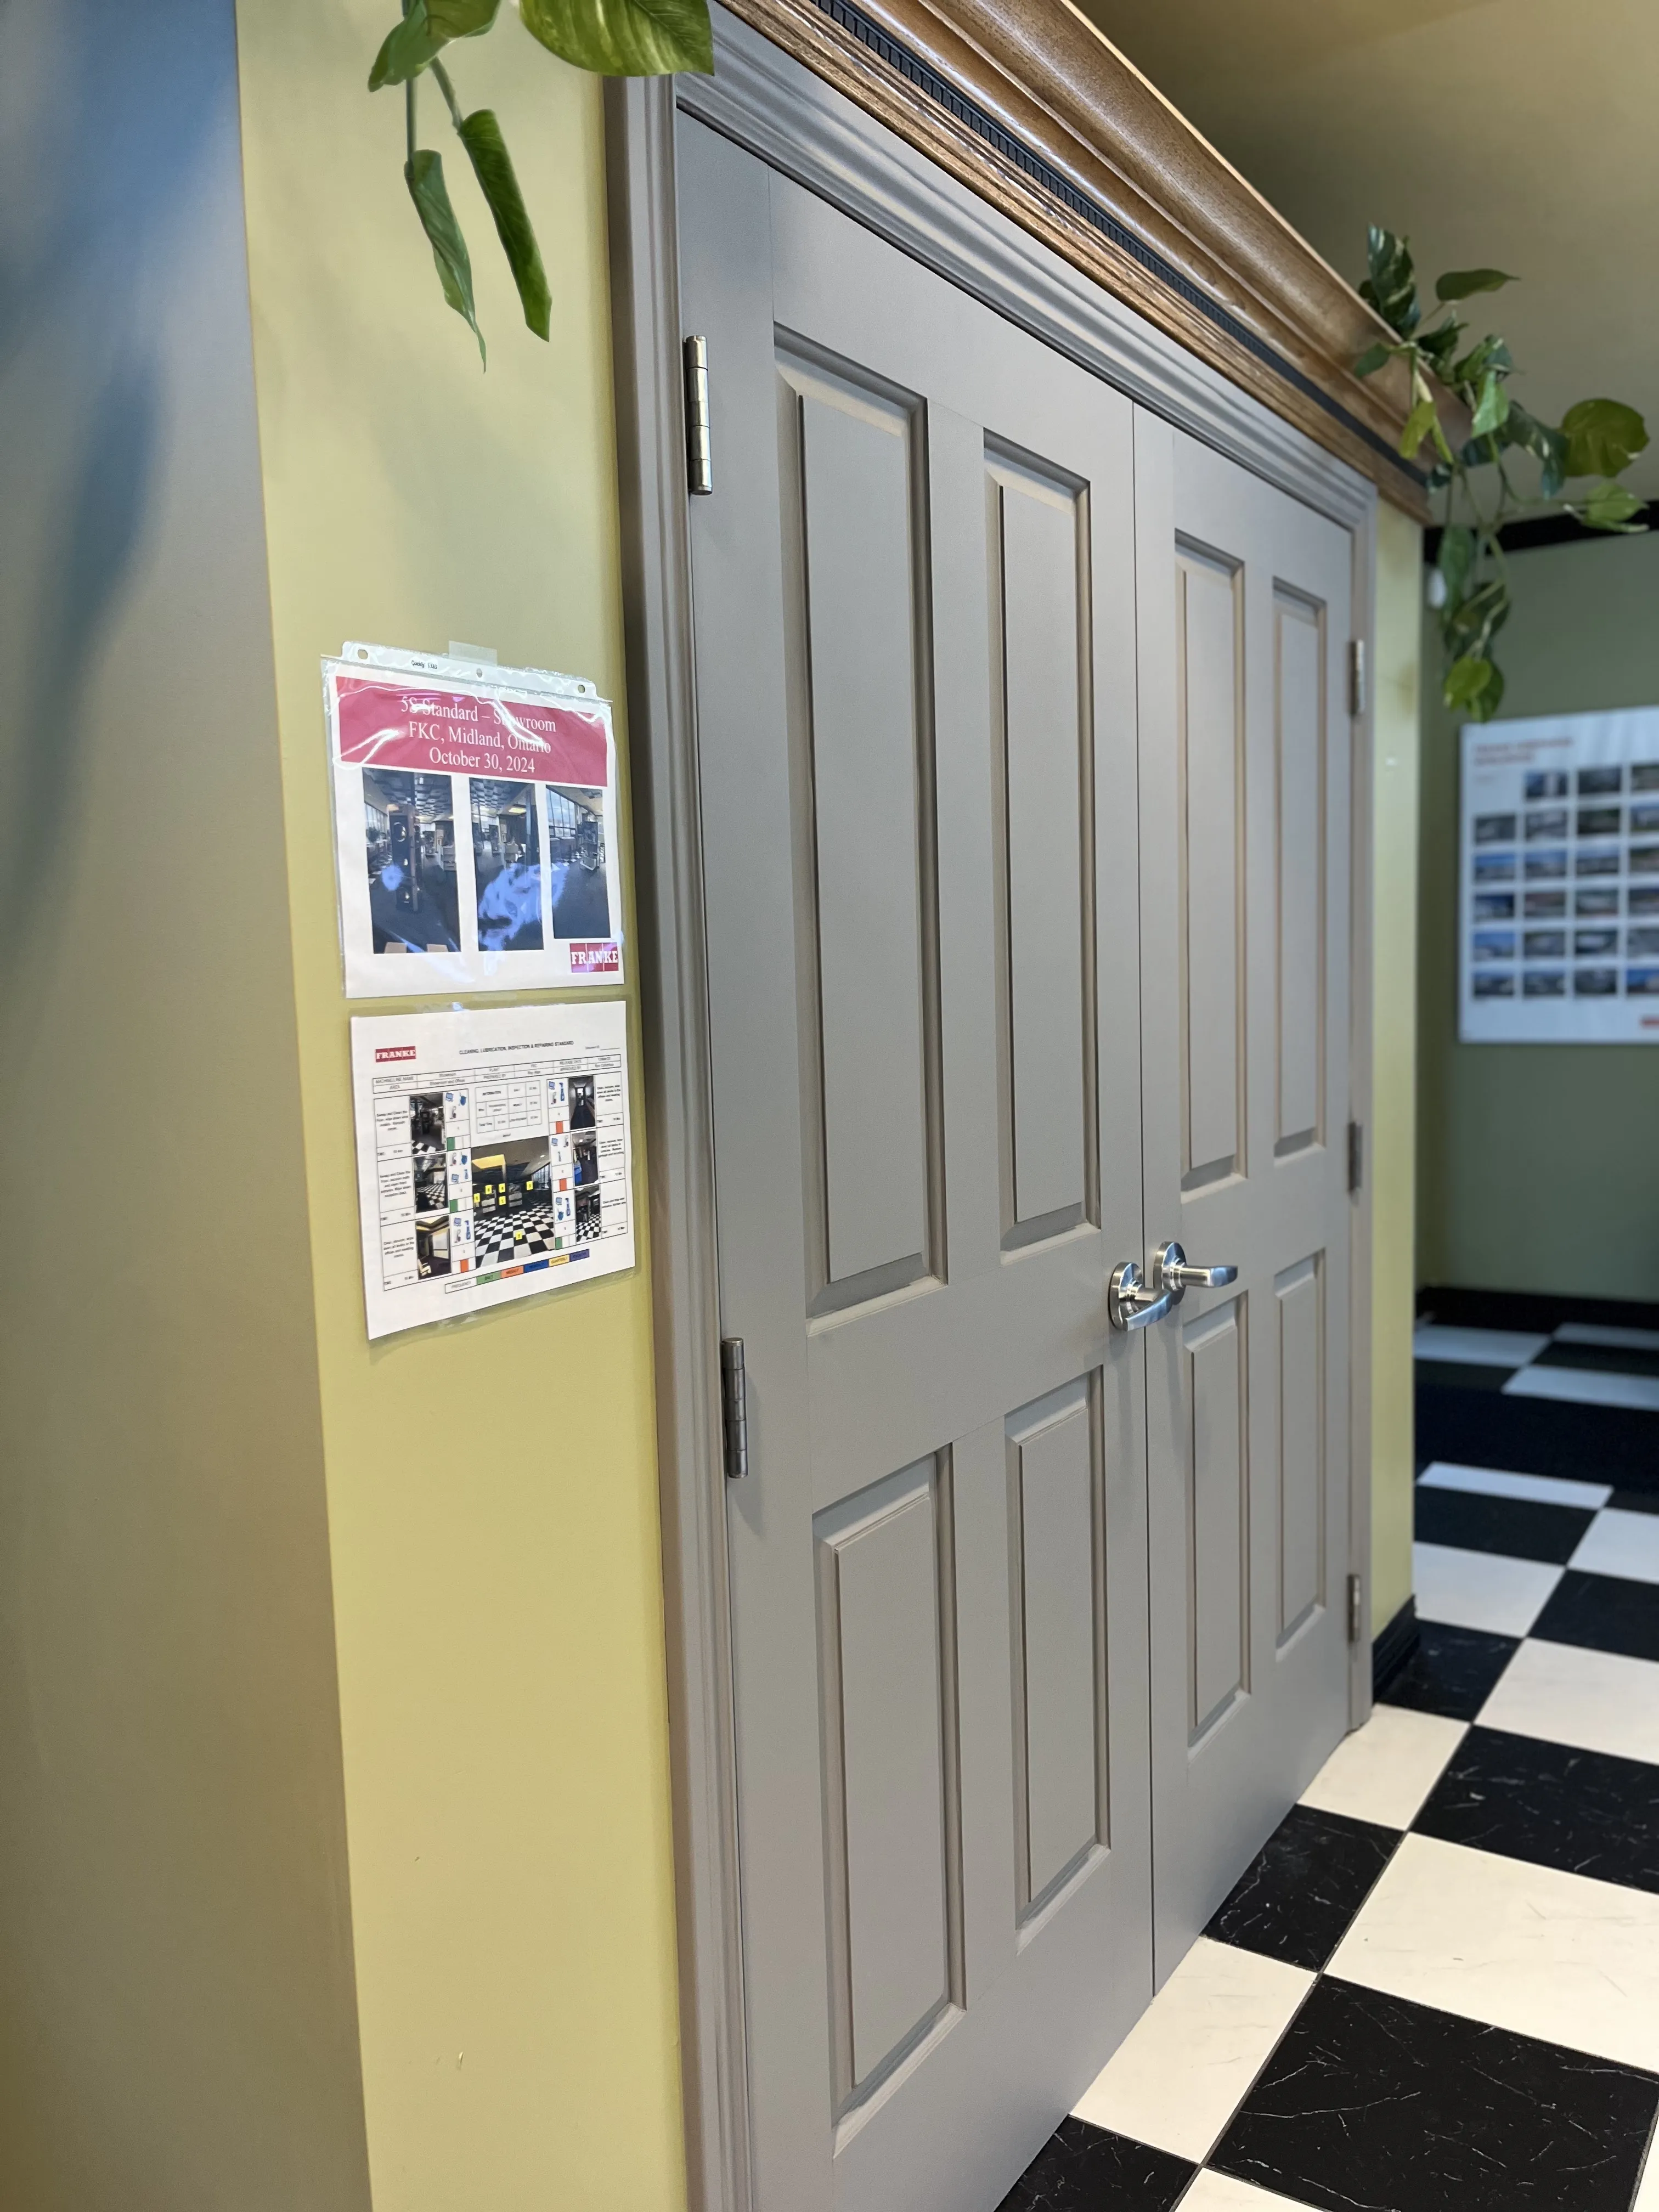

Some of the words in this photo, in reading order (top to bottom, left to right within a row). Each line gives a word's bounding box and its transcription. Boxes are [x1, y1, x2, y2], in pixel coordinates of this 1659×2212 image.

[422, 698, 479, 721] Standard
[409, 721, 444, 744] FKC,
[448, 726, 505, 751] Midland,
[430, 747, 481, 768] October
[483, 753, 503, 772] 30,
[506, 755, 535, 773] 2024
[571, 950, 618, 964] FRANKE
[376, 1049, 416, 1060] FRANKE
